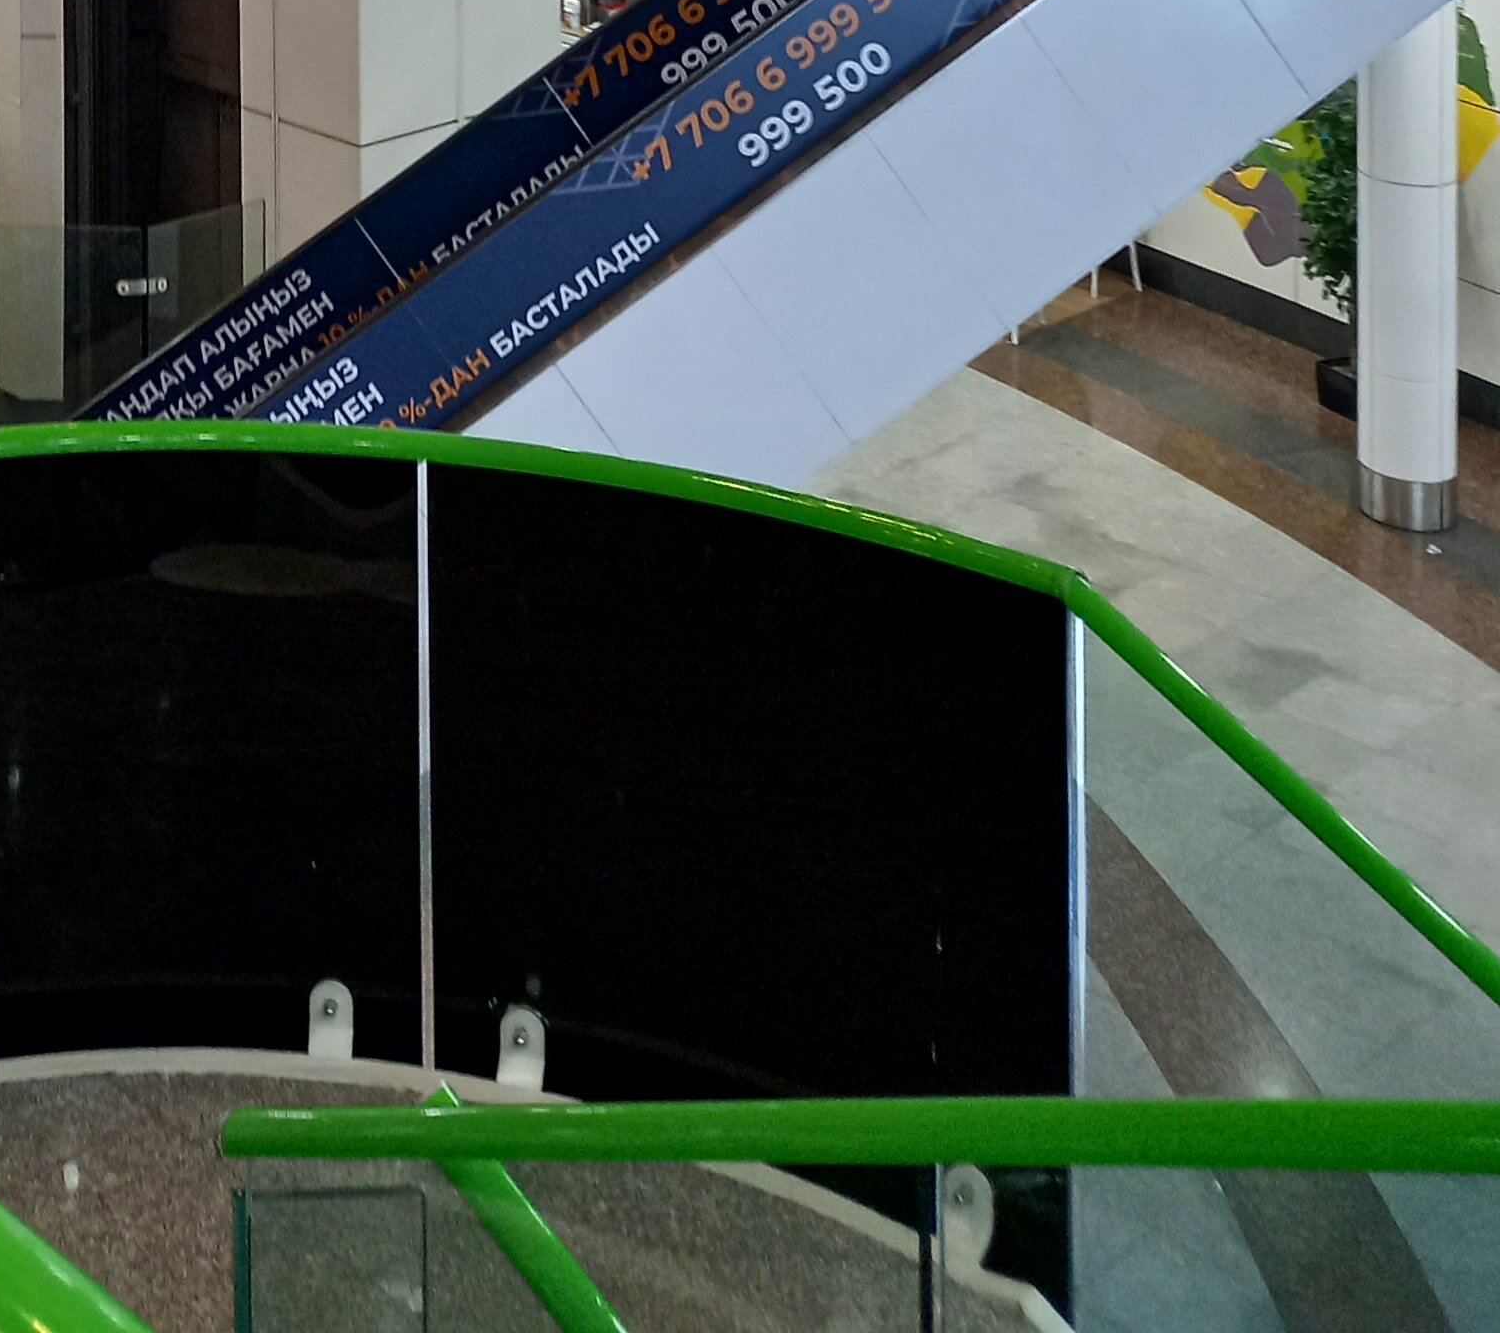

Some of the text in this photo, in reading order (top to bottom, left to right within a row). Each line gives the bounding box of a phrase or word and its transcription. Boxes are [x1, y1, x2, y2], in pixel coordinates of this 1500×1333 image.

[564, 65, 599, 109] +7
[601, 18, 678, 77] 706
[630, 136, 675, 183] +7
[675, 79, 755, 147] 706
[755, 55, 788, 94] 6
[783, 0, 862, 69] 999
[659, 31, 729, 86] 999
[736, 41, 894, 168] 999 500
[198, 268, 313, 365] АЛЫҢЫЗ
[216, 290, 336, 391] БАҒАМЕН
[399, 221, 662, 425] %-ДАН БАСТАЛАДЫ
